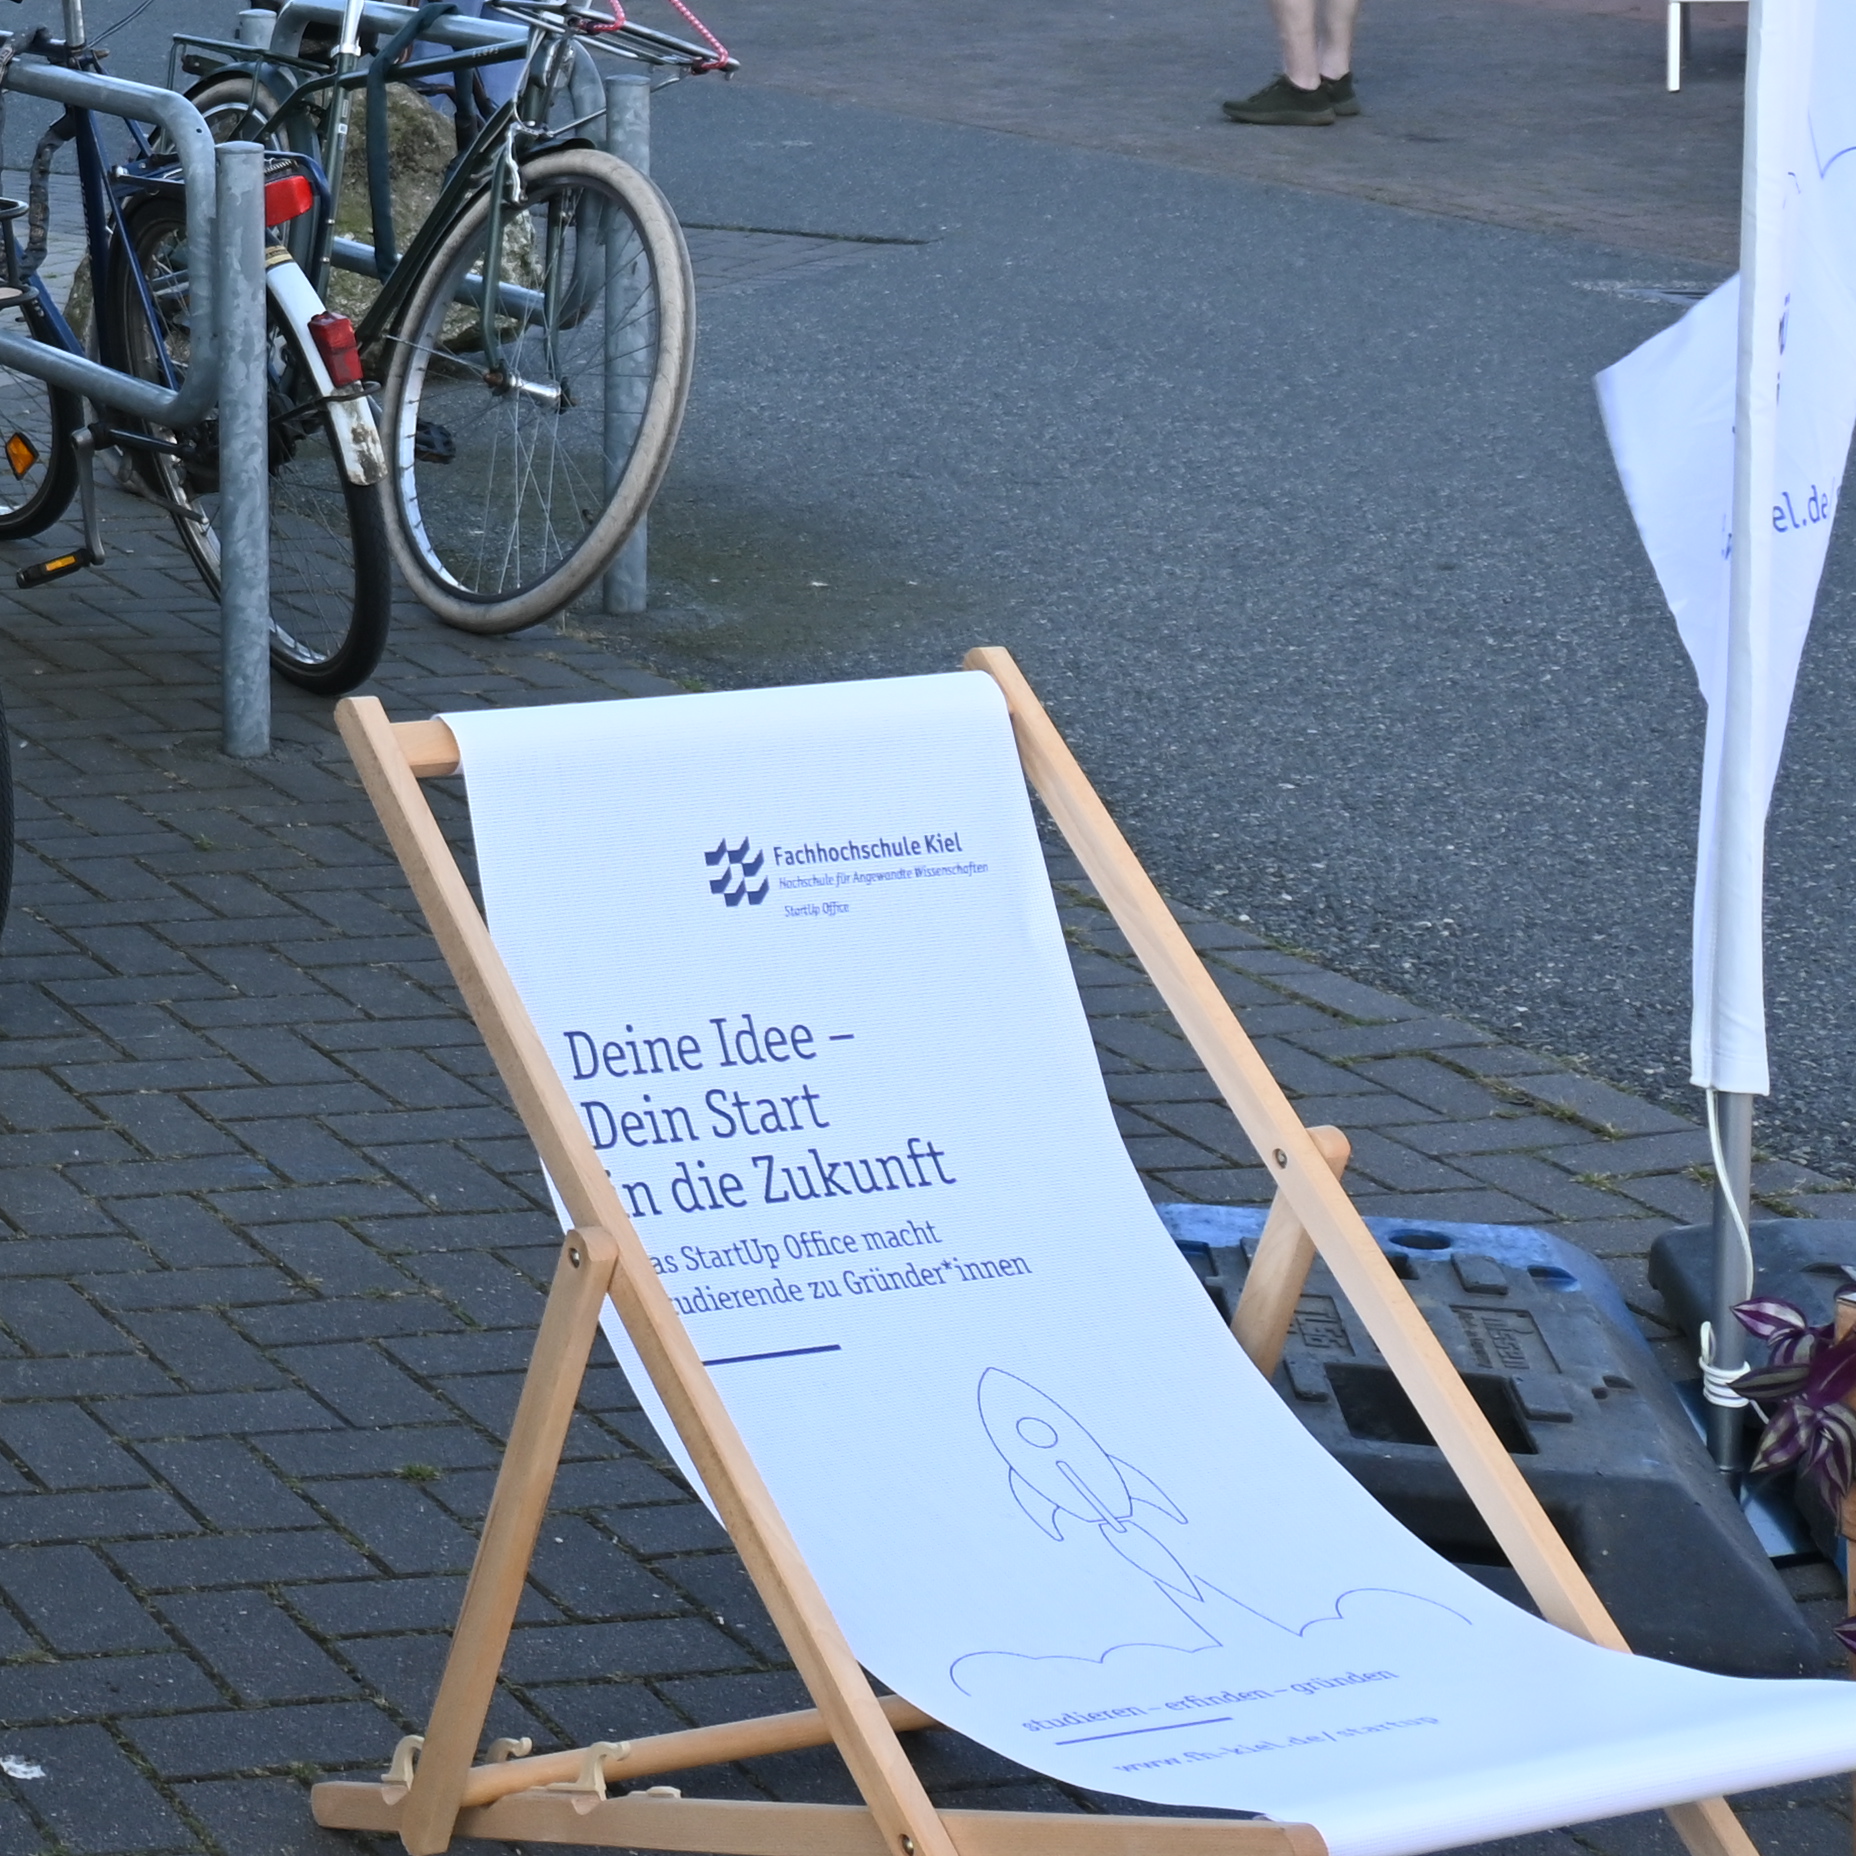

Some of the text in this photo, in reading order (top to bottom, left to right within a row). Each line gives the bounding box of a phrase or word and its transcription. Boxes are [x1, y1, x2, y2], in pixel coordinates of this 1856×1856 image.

[773, 832, 963, 866] Fachhochschule Kiel
[779, 861, 989, 890] Hochschule für Angewandte Wissenschaften
[822, 901, 850, 916] Office
[564, 1024, 703, 1080] Deine
[709, 1013, 817, 1067] Idee
[580, 1084, 830, 1149] Dein Start
[671, 1160, 748, 1213] die
[752, 1137, 957, 1204] Zukunft
[680, 1238, 781, 1274] StartUp
[782, 1230, 859, 1260] Office
[861, 1220, 943, 1251] macht
[807, 1278, 842, 1301] zu
[1022, 1704, 1147, 1732] studieren
[1164, 1687, 1275, 1713] erfinden
[1289, 1667, 1400, 1695] gründen
